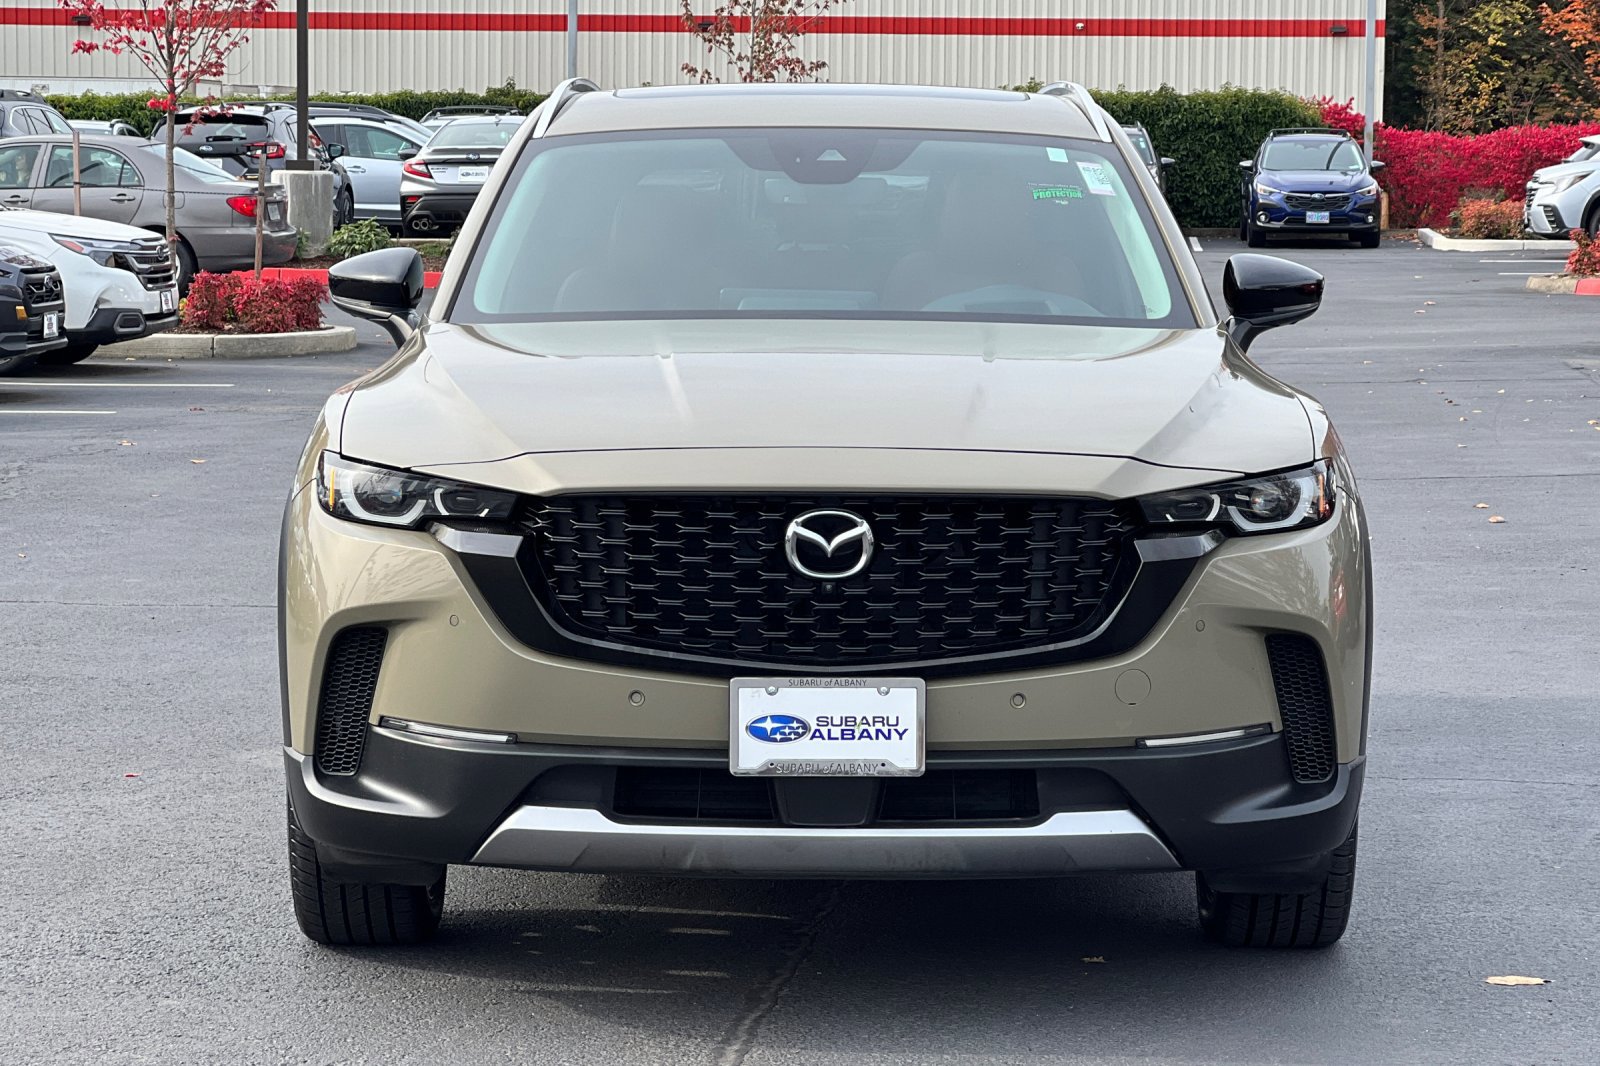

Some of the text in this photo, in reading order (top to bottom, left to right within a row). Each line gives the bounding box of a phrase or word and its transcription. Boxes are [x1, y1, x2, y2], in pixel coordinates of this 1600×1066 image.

[1032, 190, 1083, 200] PROTECTION
[788, 679, 867, 687] SUBARU of ALBANY
[816, 715, 899, 727] SUBARU
[809, 728, 909, 741] ALBANY
[775, 763, 878, 774] SUBARU of ALBANY
